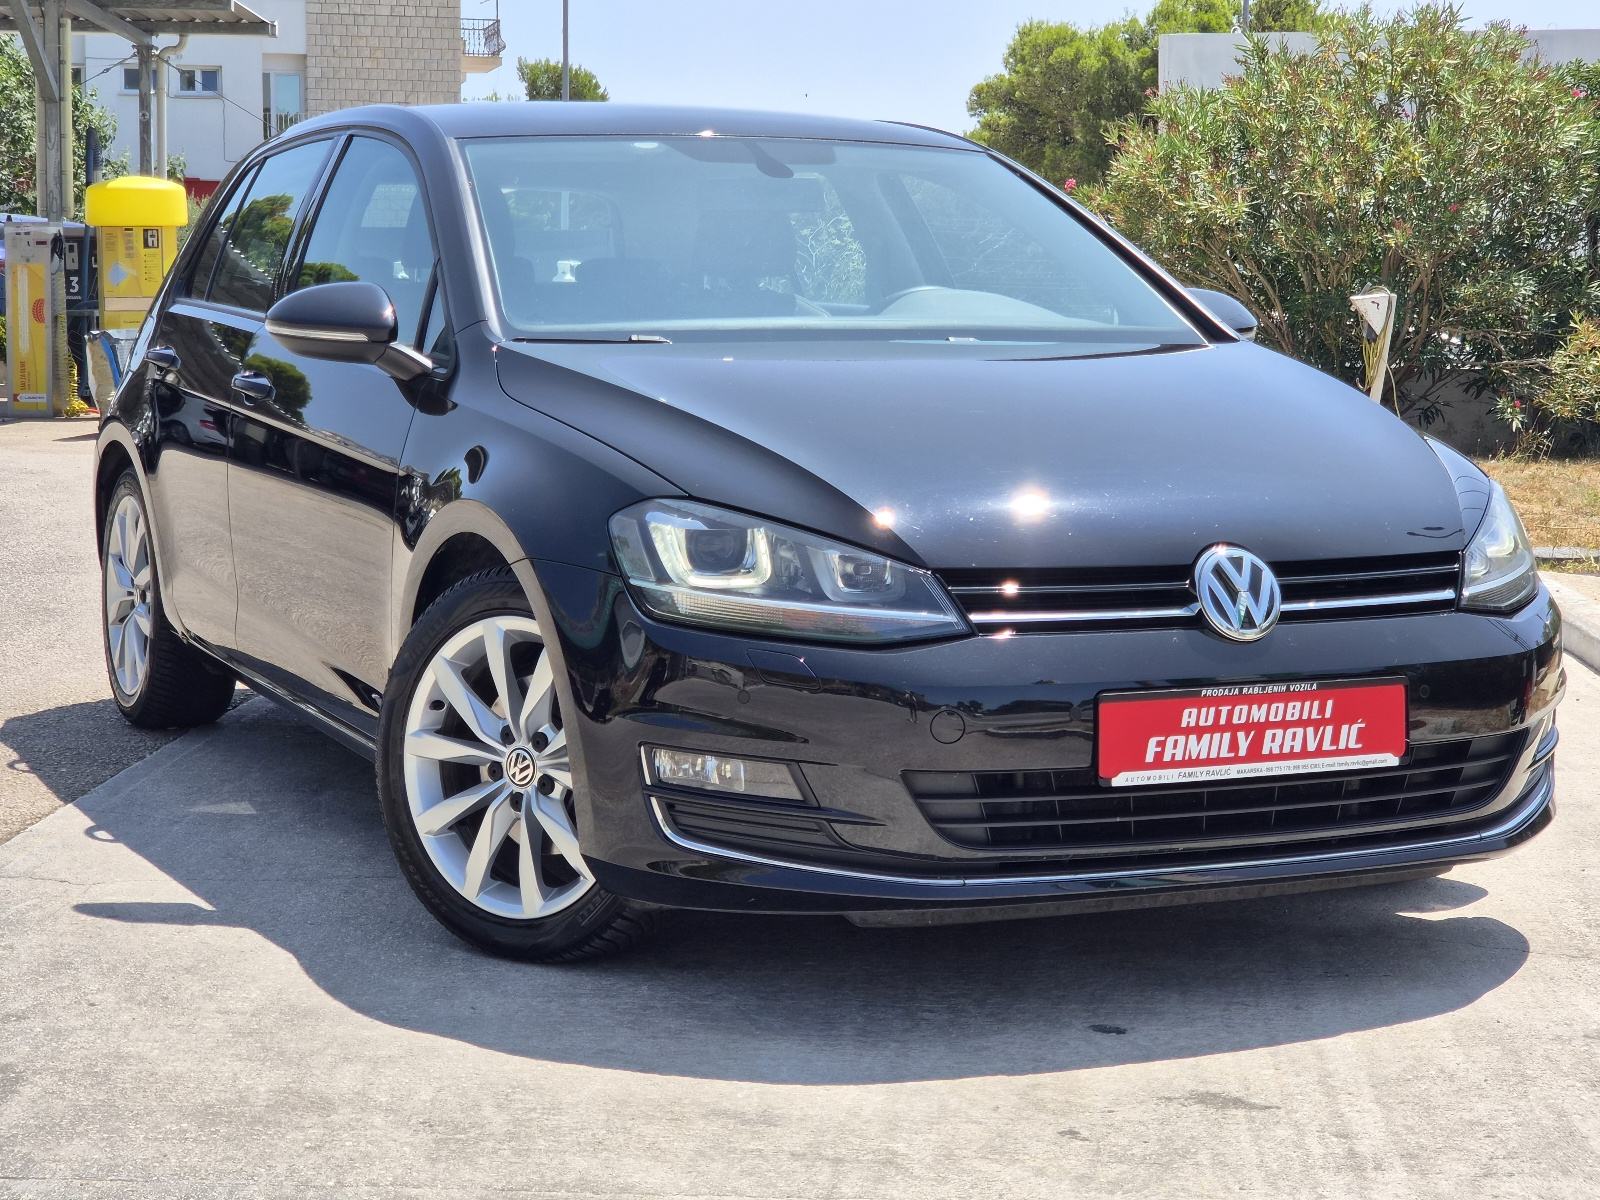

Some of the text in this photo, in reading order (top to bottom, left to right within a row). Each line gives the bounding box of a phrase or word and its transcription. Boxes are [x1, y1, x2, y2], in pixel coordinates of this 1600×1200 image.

[69, 276, 79, 293] 3
[1199, 549, 1279, 637] VW
[1201, 682, 1317, 697] PRODAJA RABLJENIH VOZILA
[1181, 699, 1333, 728] AUTOMOBILI
[1145, 719, 1366, 763] FAMILY RAVLIĆ
[1125, 774, 1174, 783] AUTOMOBILI
[1177, 769, 1204, 779] FAMILY
[1205, 767, 1232, 777] RAVLIĆ
